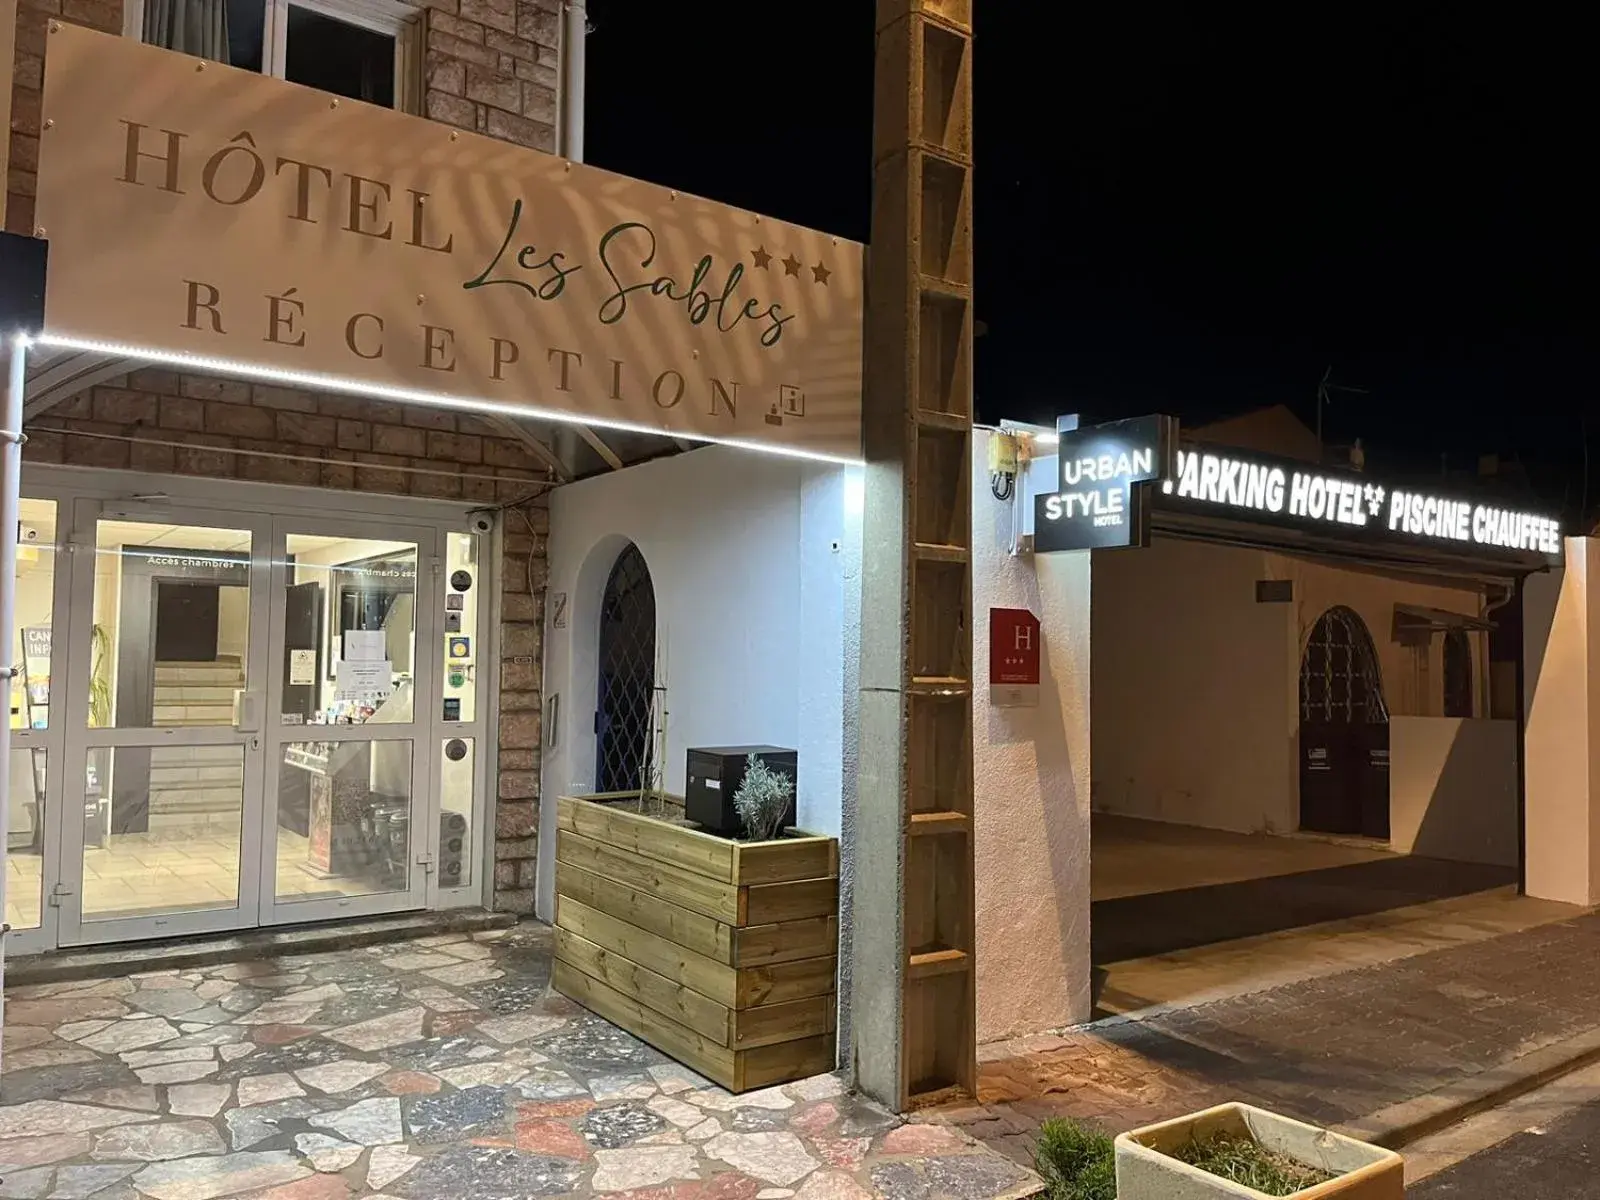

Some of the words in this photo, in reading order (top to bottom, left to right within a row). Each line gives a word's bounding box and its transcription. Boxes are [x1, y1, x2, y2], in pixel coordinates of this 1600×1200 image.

[115, 119, 453, 254] HÔTEL
[463, 199, 583, 300] Les
[599, 222, 795, 347] Sables
[180, 278, 742, 420] RÉCEPTION
[1064, 447, 1152, 485] URBAN
[1045, 488, 1124, 520] STYLE
[1093, 515, 1124, 527] HOTEL
[1289, 471, 1366, 526] HOTEL
[1388, 491, 1470, 541] PISCINE
[1472, 505, 1561, 554] CHAUFFEE
[181, 557, 234, 569] chambres
[1014, 625, 1032, 650] H
